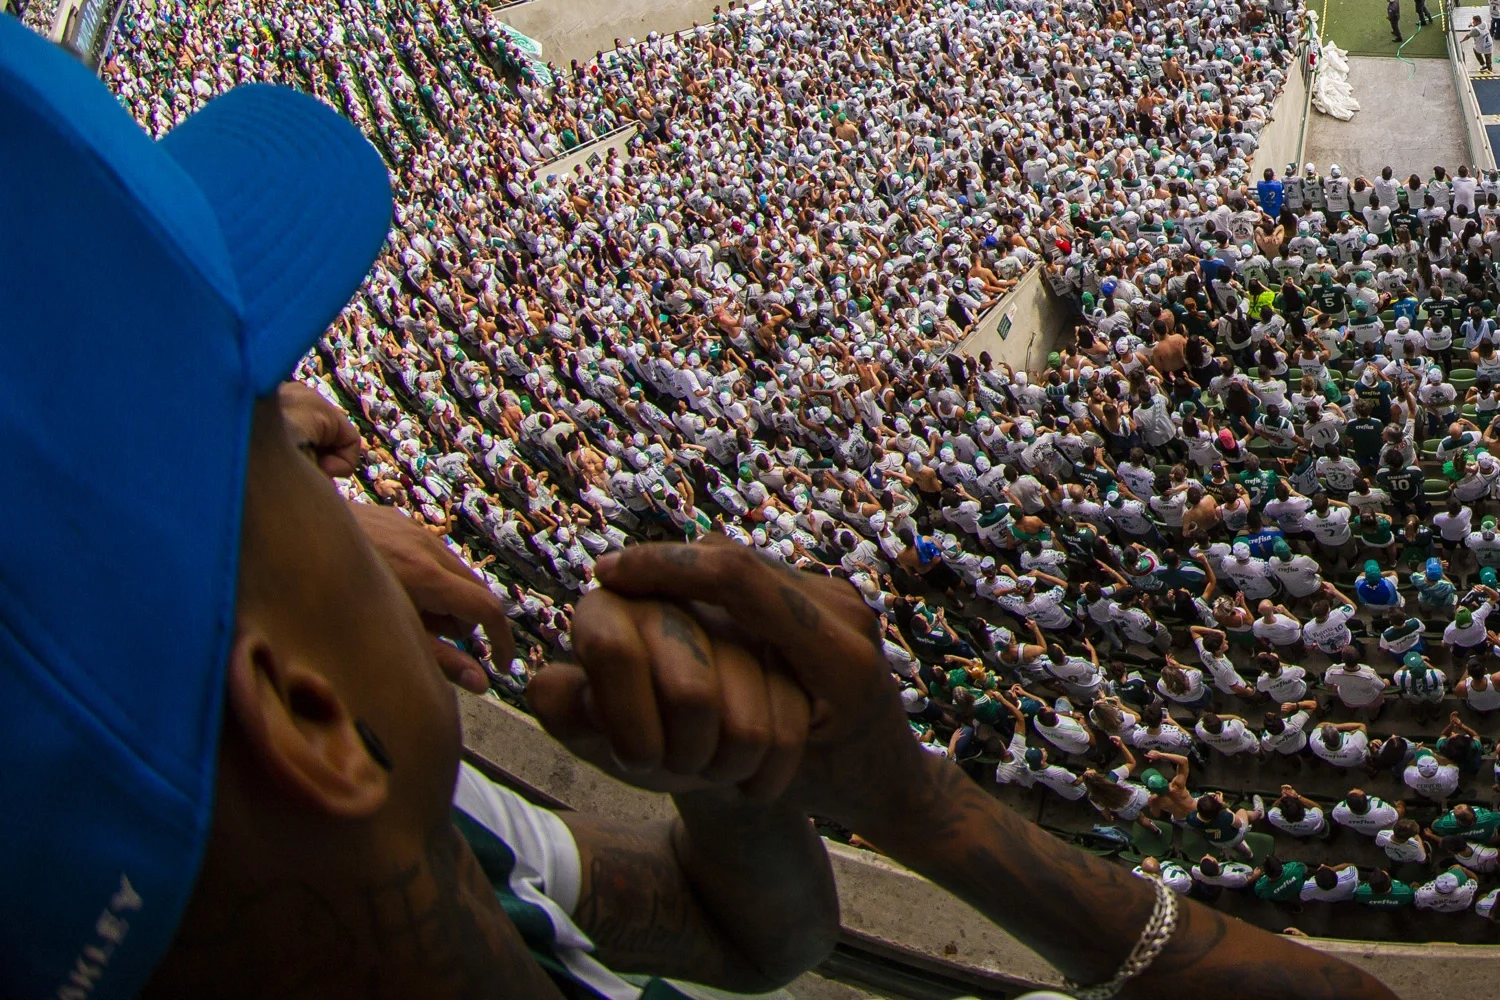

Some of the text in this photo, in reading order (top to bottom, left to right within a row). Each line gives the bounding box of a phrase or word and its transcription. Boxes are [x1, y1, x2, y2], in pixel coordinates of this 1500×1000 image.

[1390, 479, 1410, 490] 10
[1248, 534, 1272, 545] crefisa
[1269, 679, 1293, 691] crefisa
[1272, 876, 1298, 895] crefisa
